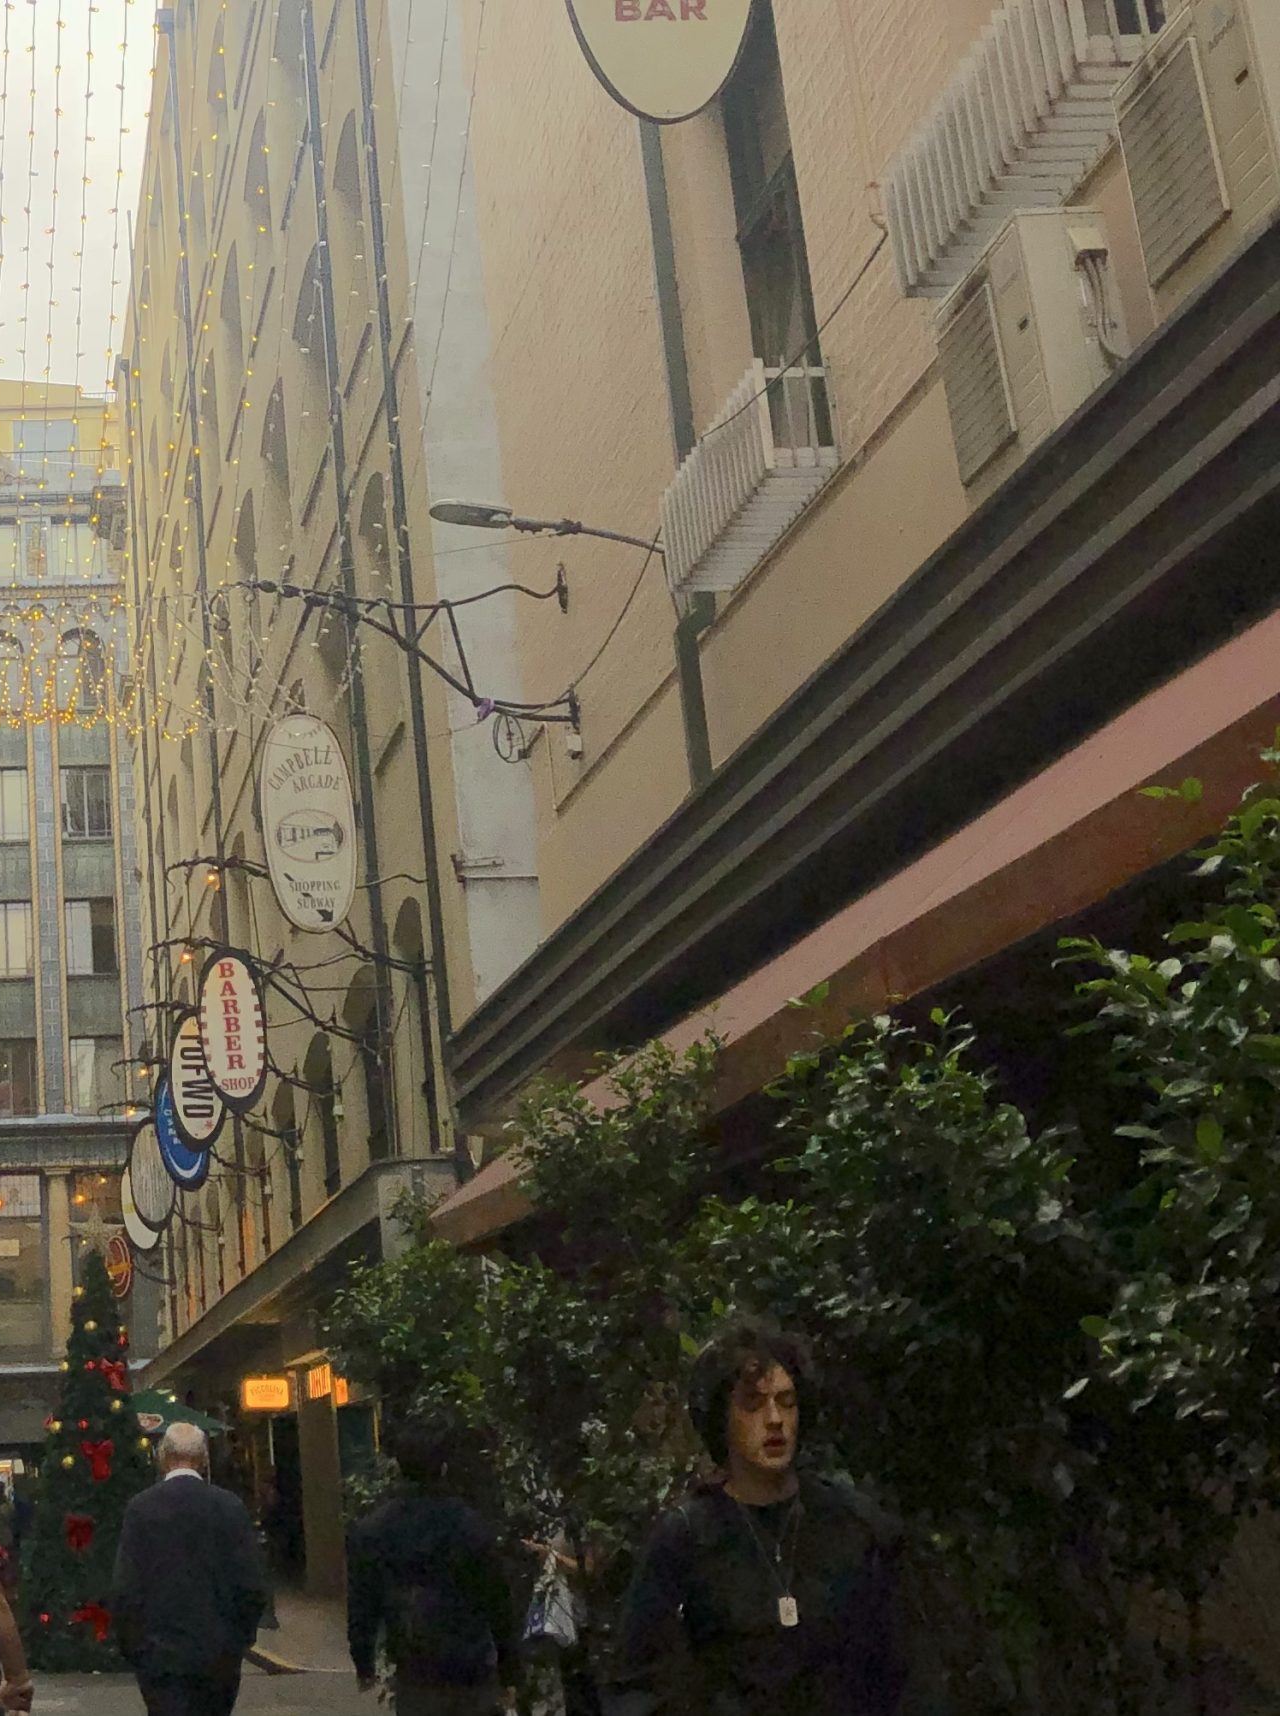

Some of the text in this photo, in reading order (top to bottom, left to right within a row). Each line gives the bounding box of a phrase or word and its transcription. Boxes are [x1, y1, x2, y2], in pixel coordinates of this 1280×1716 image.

[614, 0, 708, 22] BAR
[268, 745, 333, 790] CAMPBELL
[293, 774, 342, 793] ARCADE
[289, 880, 341, 892] SHOPPING
[297, 897, 335, 909] SUBWAY
[218, 962, 246, 1070] BARBER
[222, 1077, 255, 1091] SHOP
